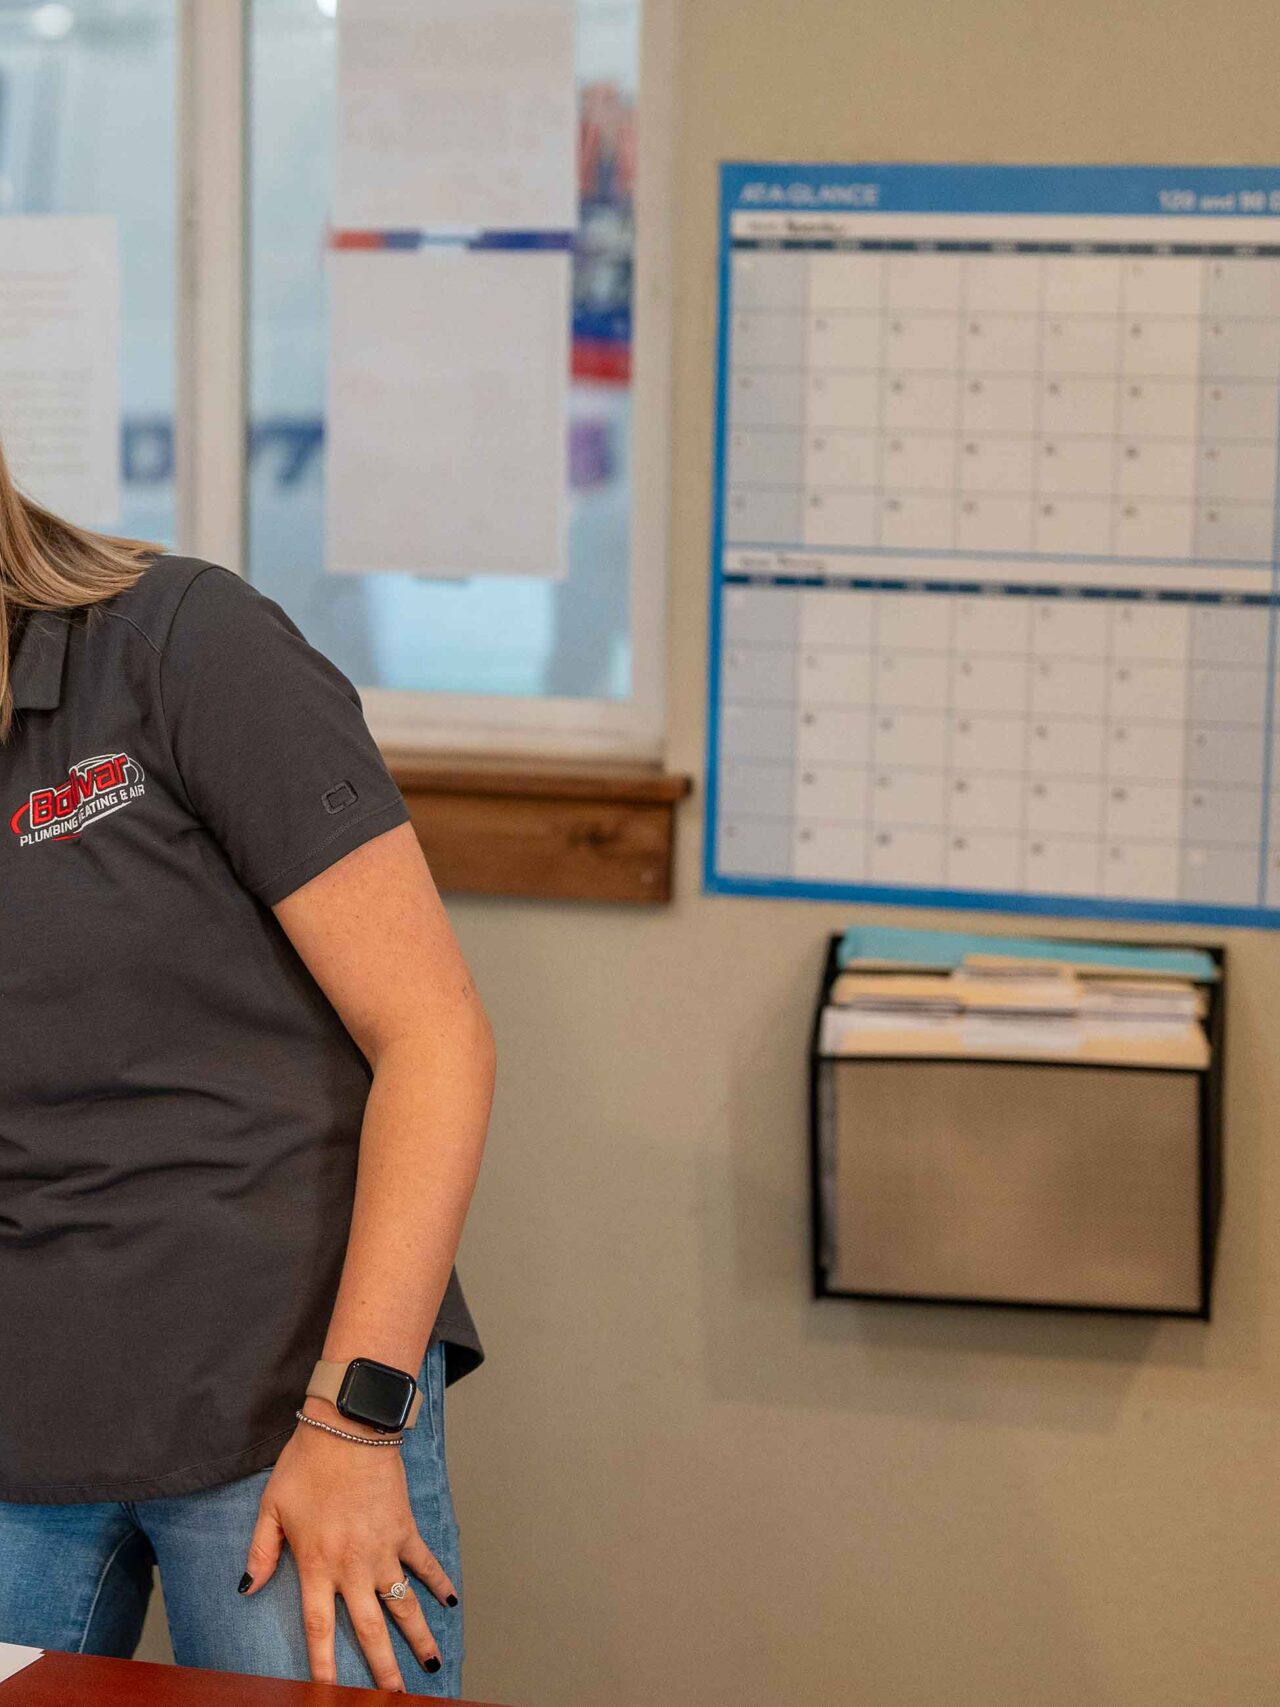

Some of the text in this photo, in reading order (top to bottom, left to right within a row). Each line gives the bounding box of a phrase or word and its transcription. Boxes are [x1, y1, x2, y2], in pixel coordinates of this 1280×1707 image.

[20, 817, 78, 847] PLUMBING
[119, 790, 128, 801] &
[129, 784, 145, 799] AIR
